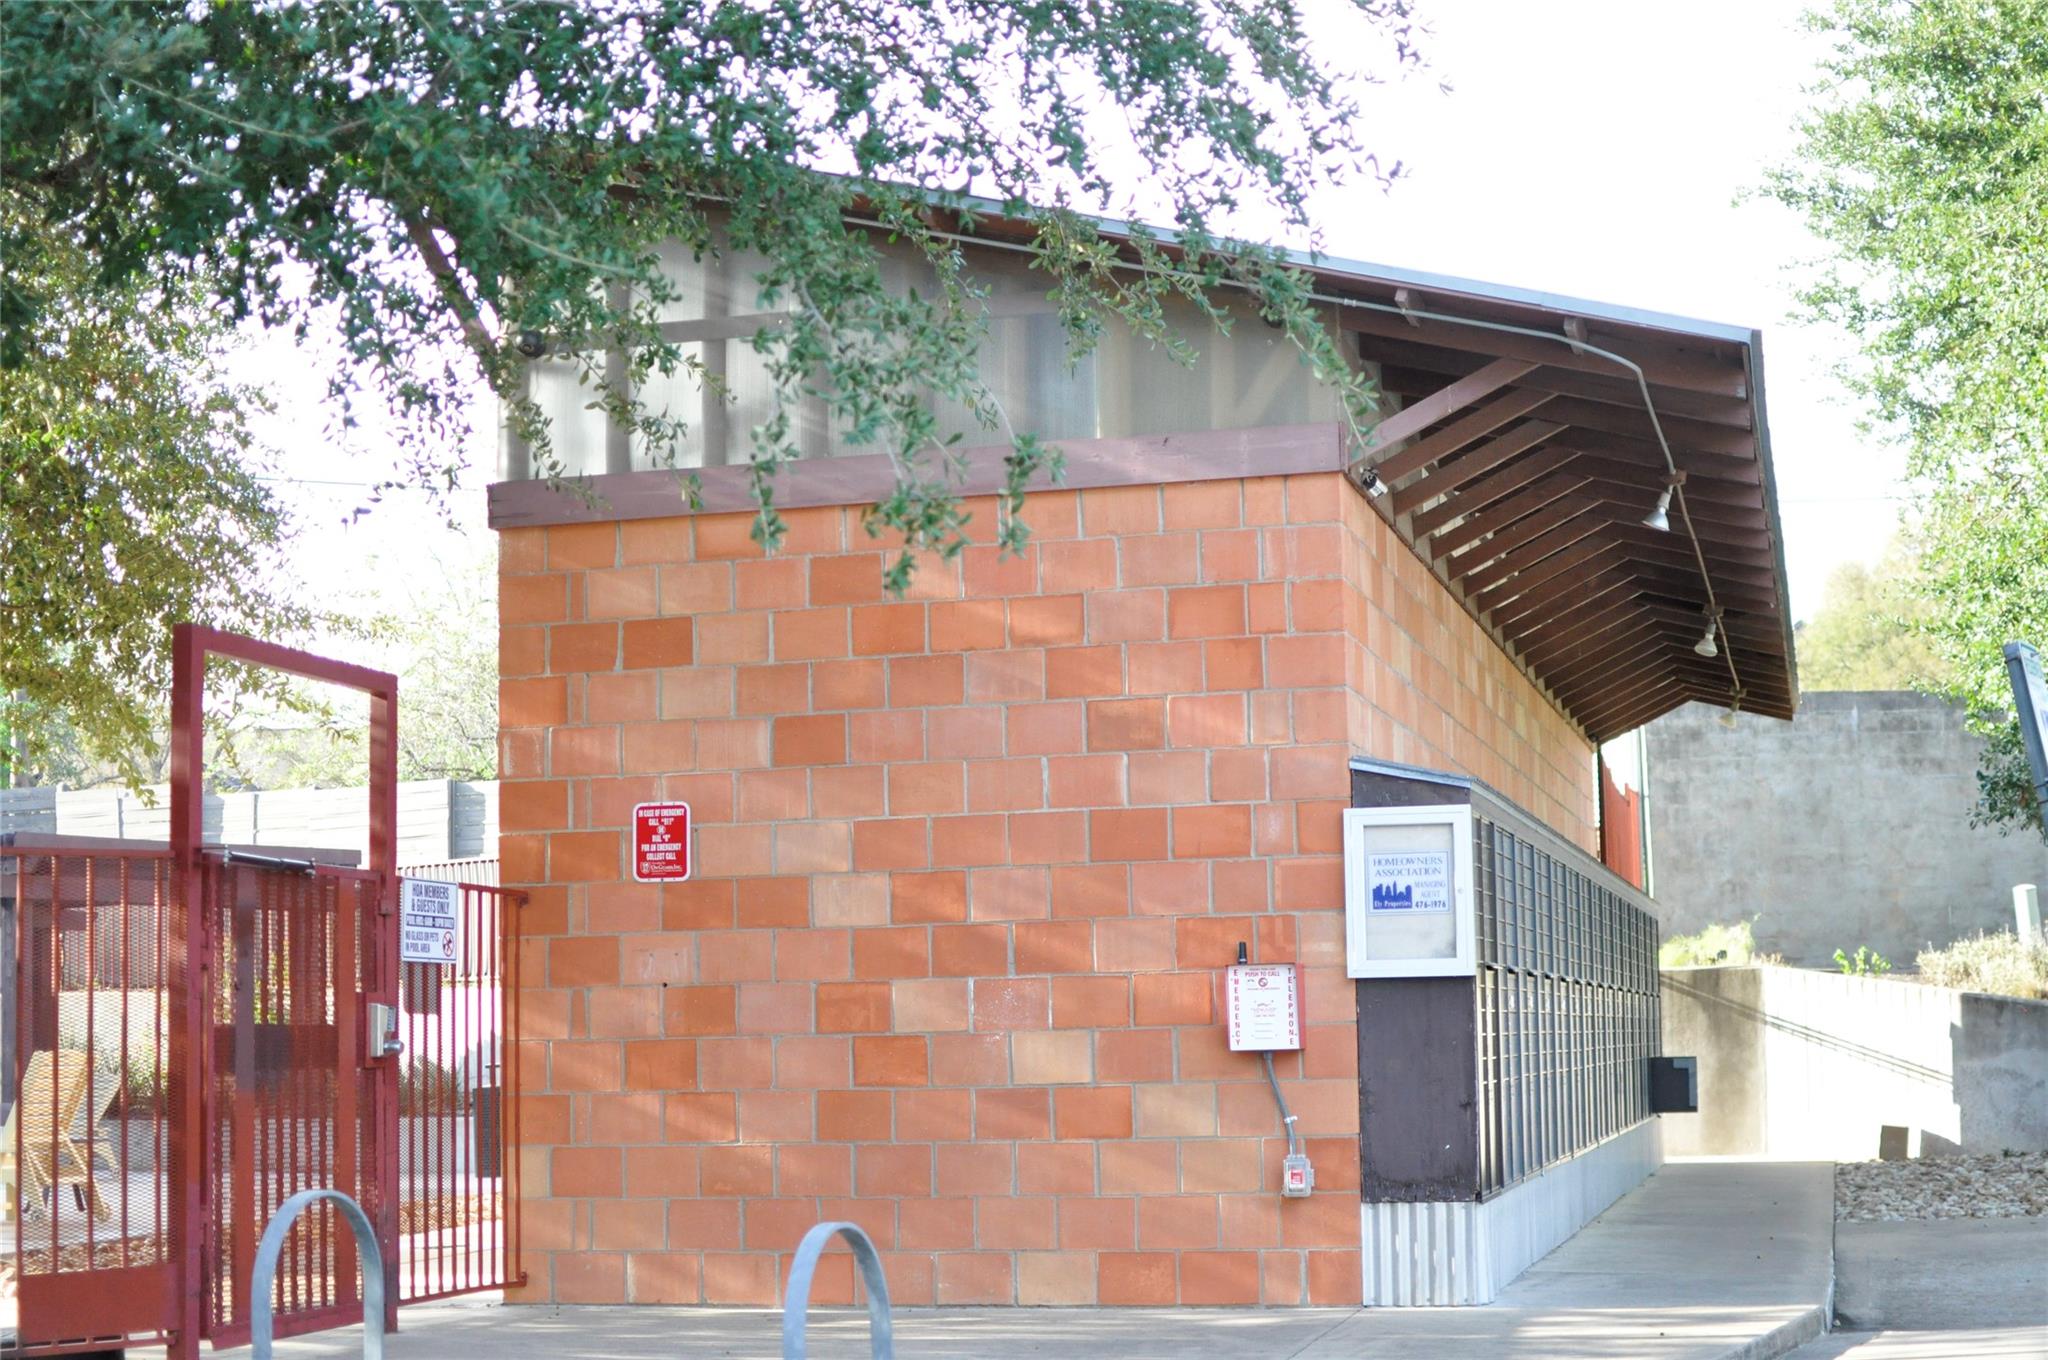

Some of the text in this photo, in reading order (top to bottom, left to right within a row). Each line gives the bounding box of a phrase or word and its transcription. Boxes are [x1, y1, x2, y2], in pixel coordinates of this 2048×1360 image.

[644, 809, 654, 817] CASE
[655, 809, 660, 817] OF
[661, 808, 684, 817] EMERGENCY
[648, 818, 659, 826] CALL
[641, 844, 650, 852] FOR
[657, 843, 681, 851] EMERGENCY
[646, 852, 676, 861] COLLECT CALL
[1373, 856, 1443, 866] HOMEOWNERS
[1375, 867, 1441, 877] ASSOCIATION
[412, 883, 449, 900] HOA MEMBERS
[417, 899, 436, 914] GUESTS
[437, 900, 449, 914] ONLY
[411, 931, 424, 941] GLASS
[410, 942, 420, 953] POOL
[1233, 969, 1241, 1046] EMERGENCY
